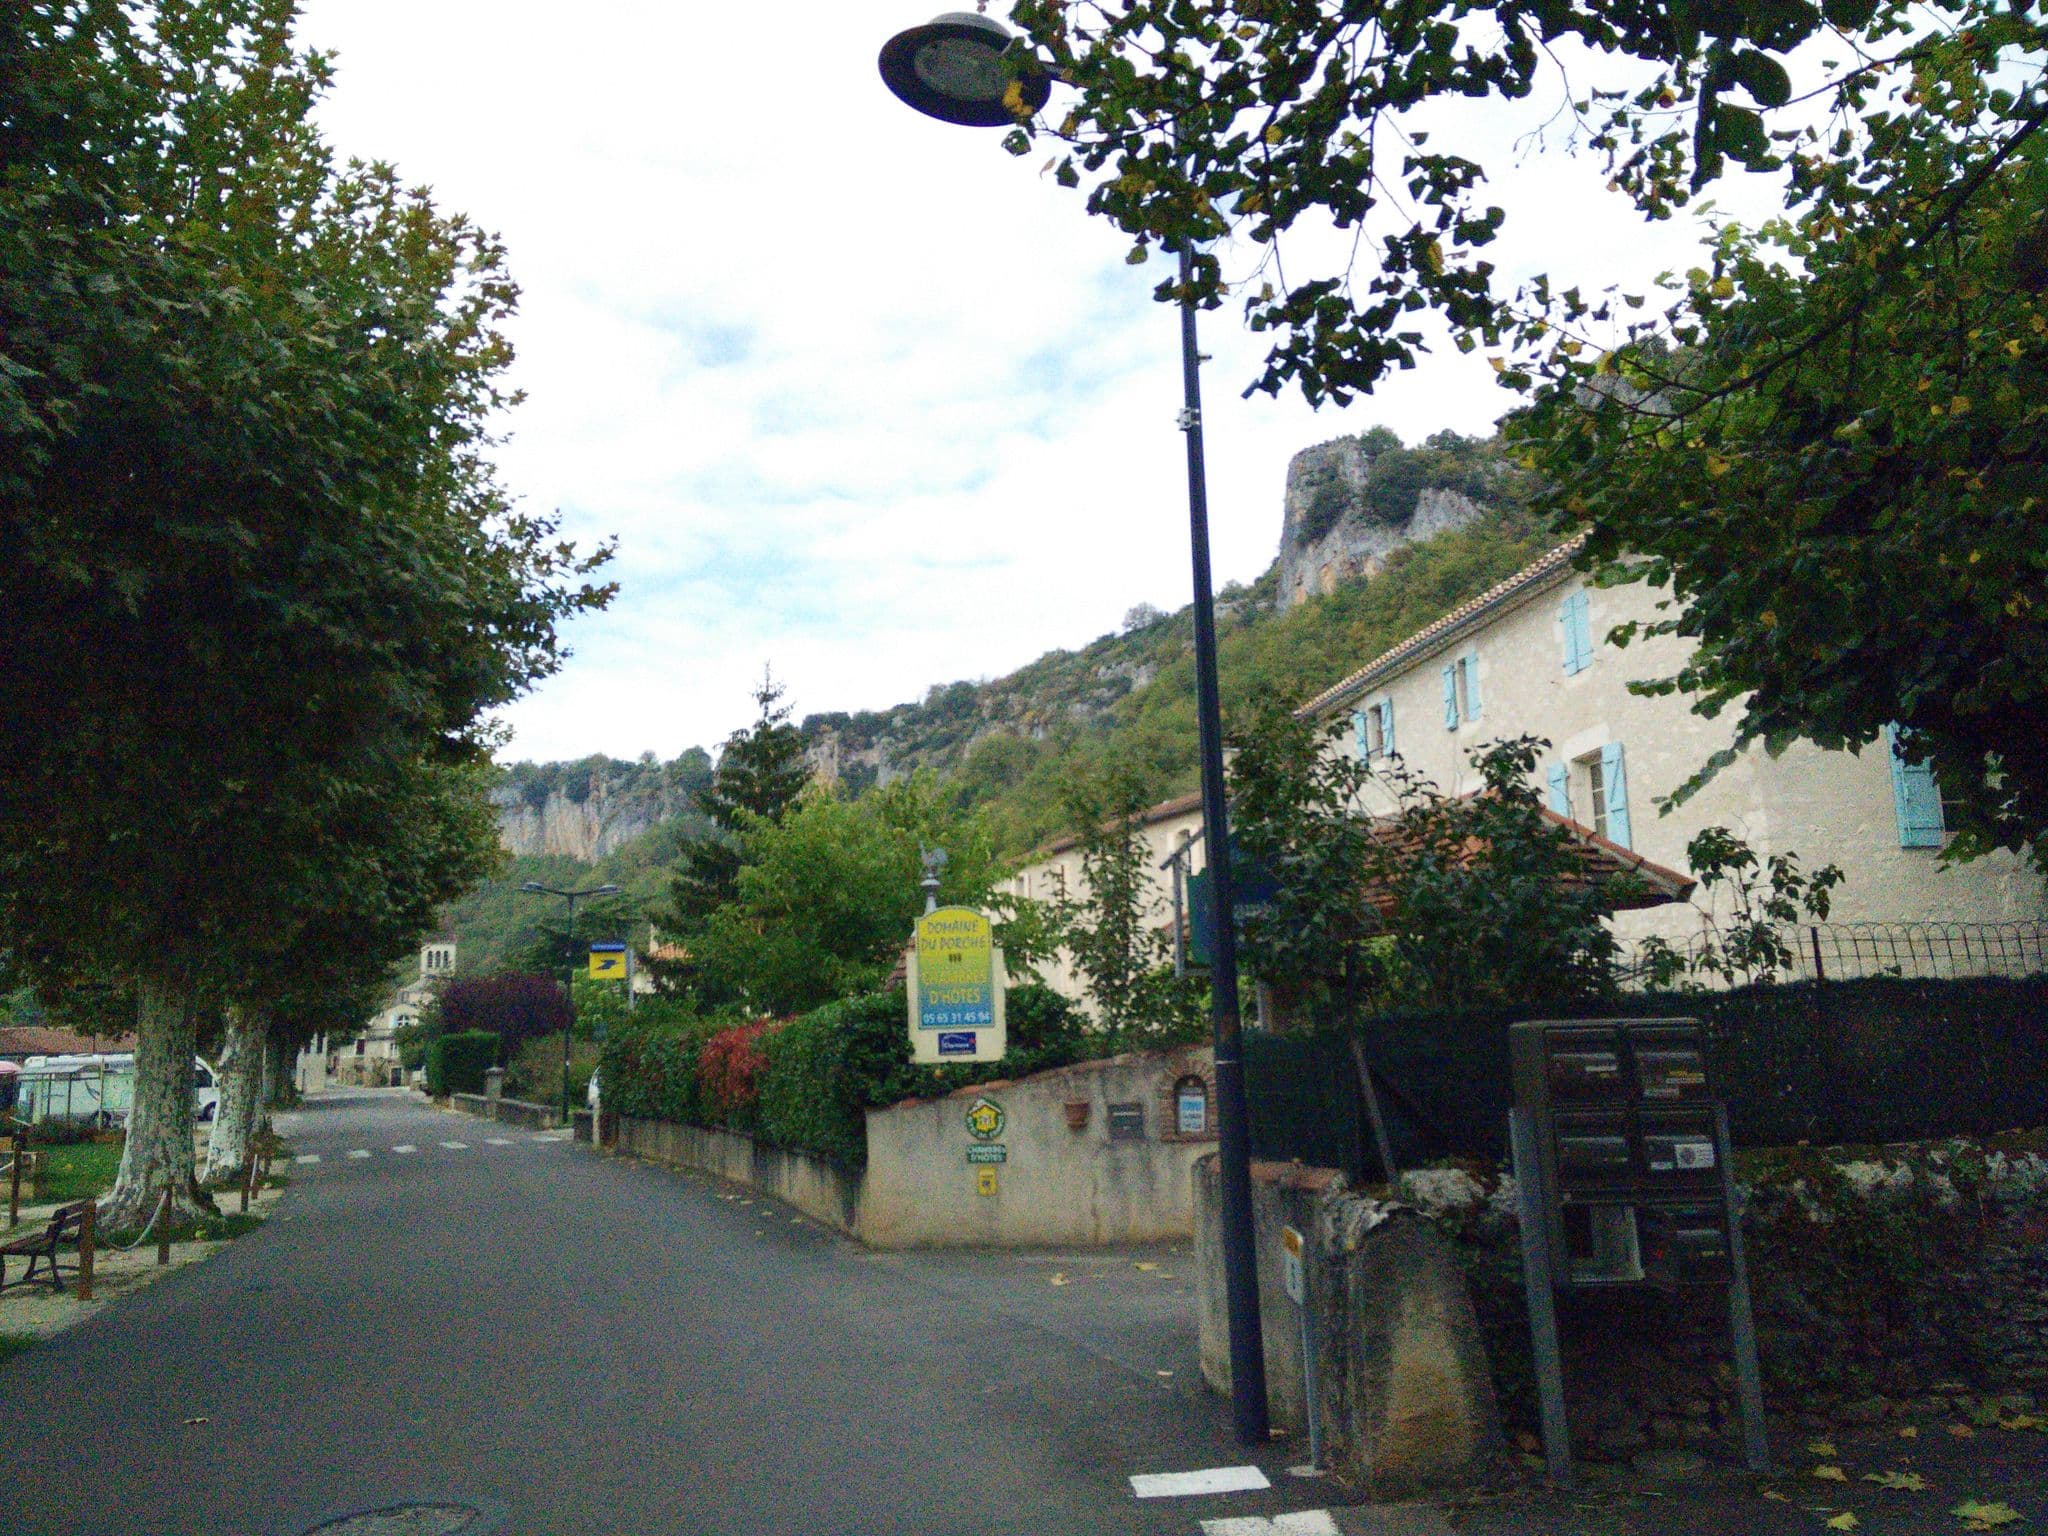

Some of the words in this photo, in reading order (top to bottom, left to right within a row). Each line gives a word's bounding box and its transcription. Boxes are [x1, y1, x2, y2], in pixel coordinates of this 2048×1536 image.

[927, 919, 979, 935] DOMAINE
[921, 937, 937, 951] DU
[940, 935, 986, 950] PORCHE
[923, 1013, 935, 1024] 05
[951, 1012, 961, 1023] 31
